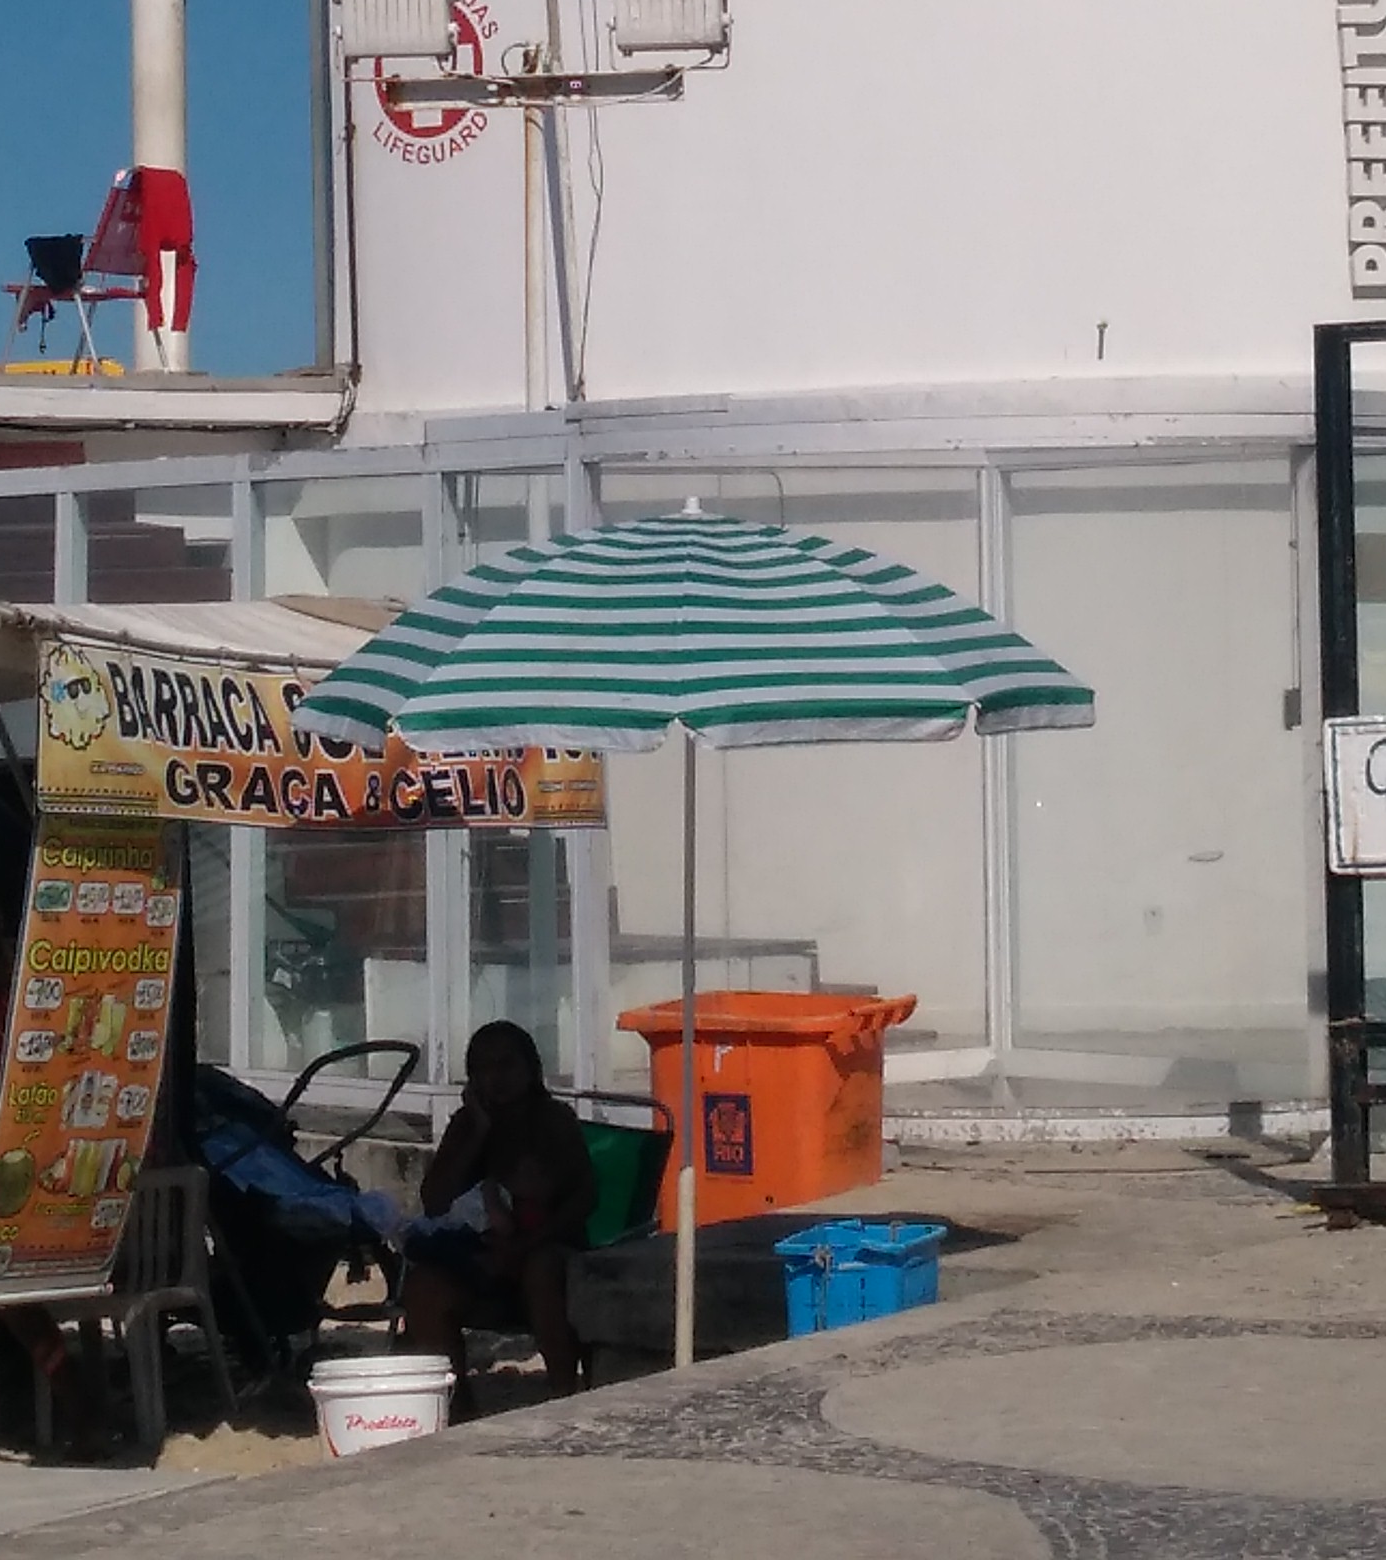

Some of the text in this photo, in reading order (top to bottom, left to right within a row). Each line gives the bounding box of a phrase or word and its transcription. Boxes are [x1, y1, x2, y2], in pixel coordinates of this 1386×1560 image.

[371, 112, 489, 164] LIFEGUARD
[106, 661, 283, 755] BARRACA
[29, 940, 169, 976] Caipivodka
